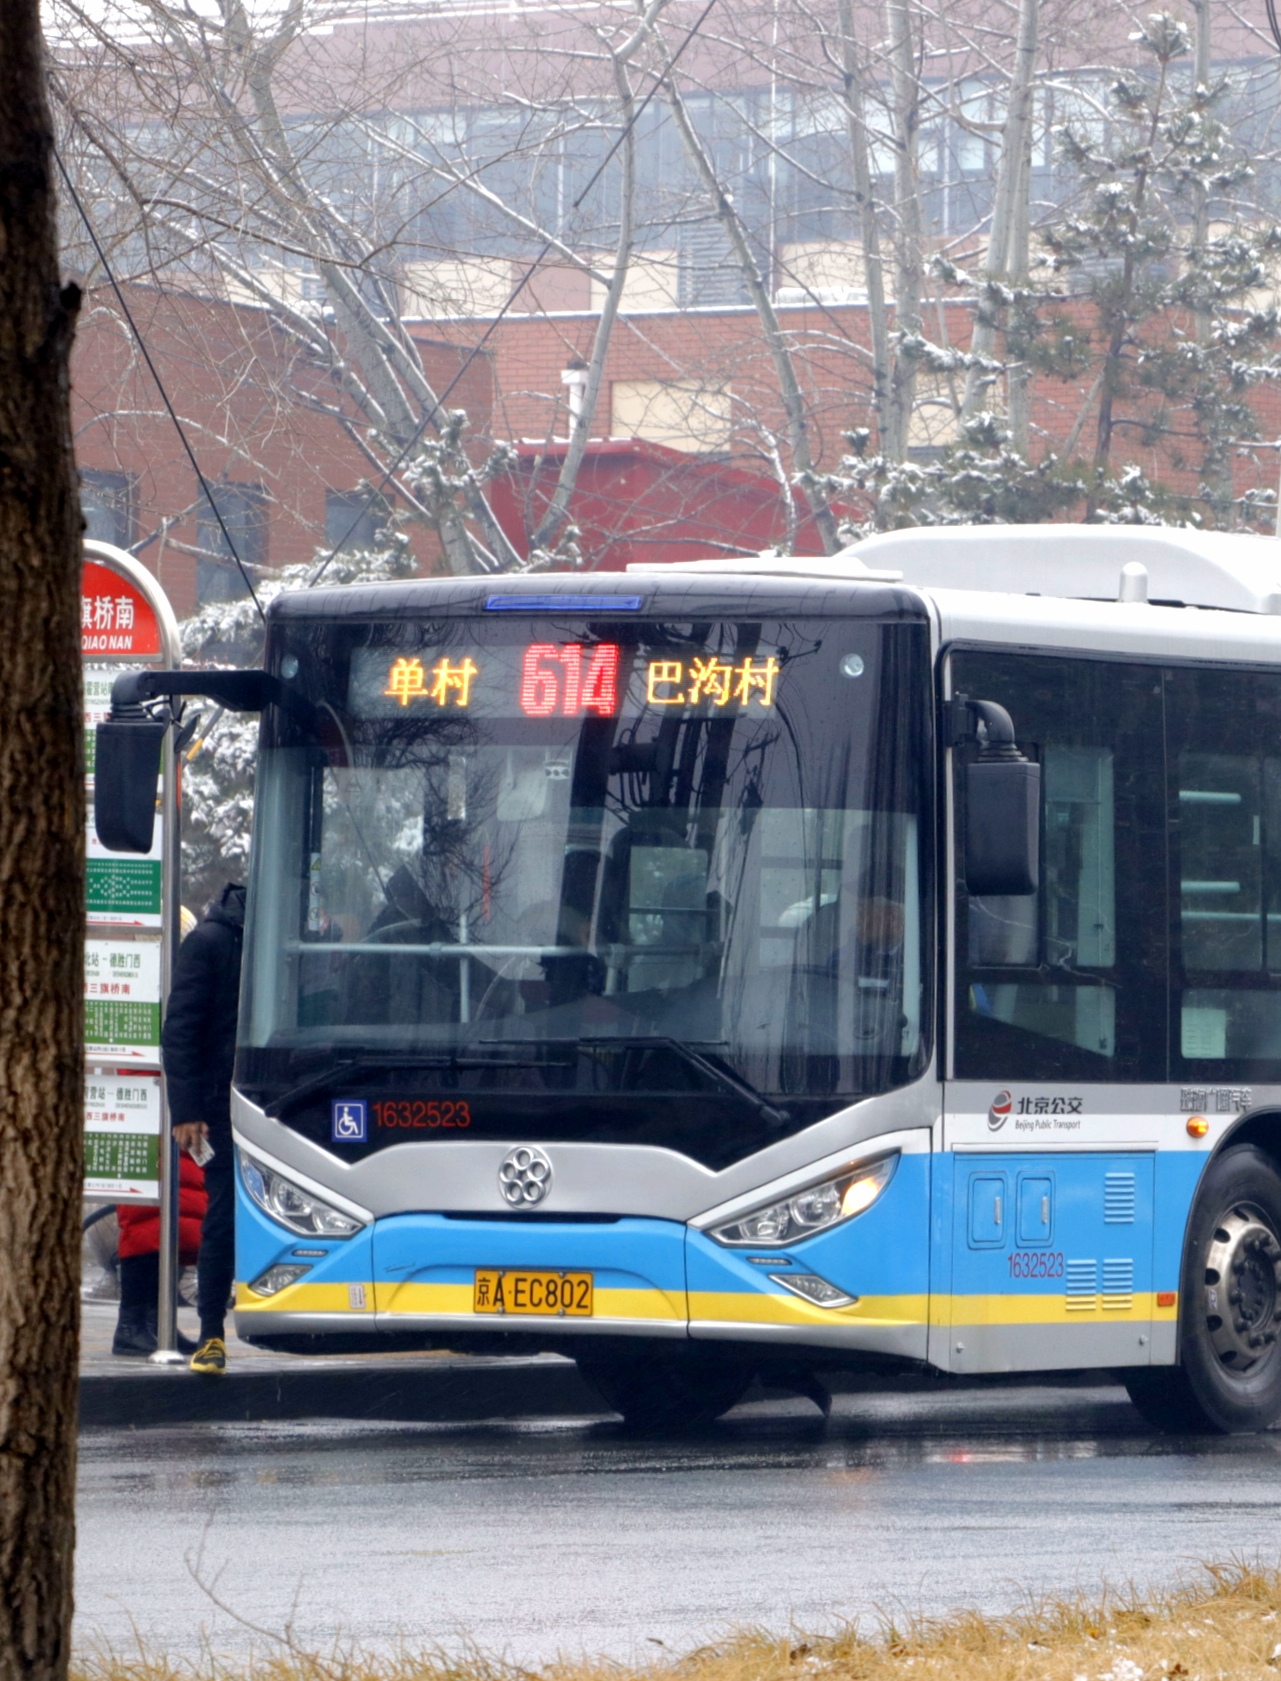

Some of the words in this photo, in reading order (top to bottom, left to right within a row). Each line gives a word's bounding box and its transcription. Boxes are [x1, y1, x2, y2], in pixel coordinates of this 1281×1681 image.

[81, 635, 108, 650] QIAO
[108, 635, 133, 650] NAN
[384, 657, 478, 707] 单村
[519, 643, 619, 717] 614
[645, 657, 779, 707] 巴沟村
[371, 1100, 471, 1128] 1632523
[1017, 1097, 1083, 1115] 北京公交
[1015, 1119, 1034, 1132] Beijing
[1035, 1119, 1051, 1130] Public
[1053, 1119, 1081, 1131] Transport
[1008, 1253, 1064, 1279] 1632523
